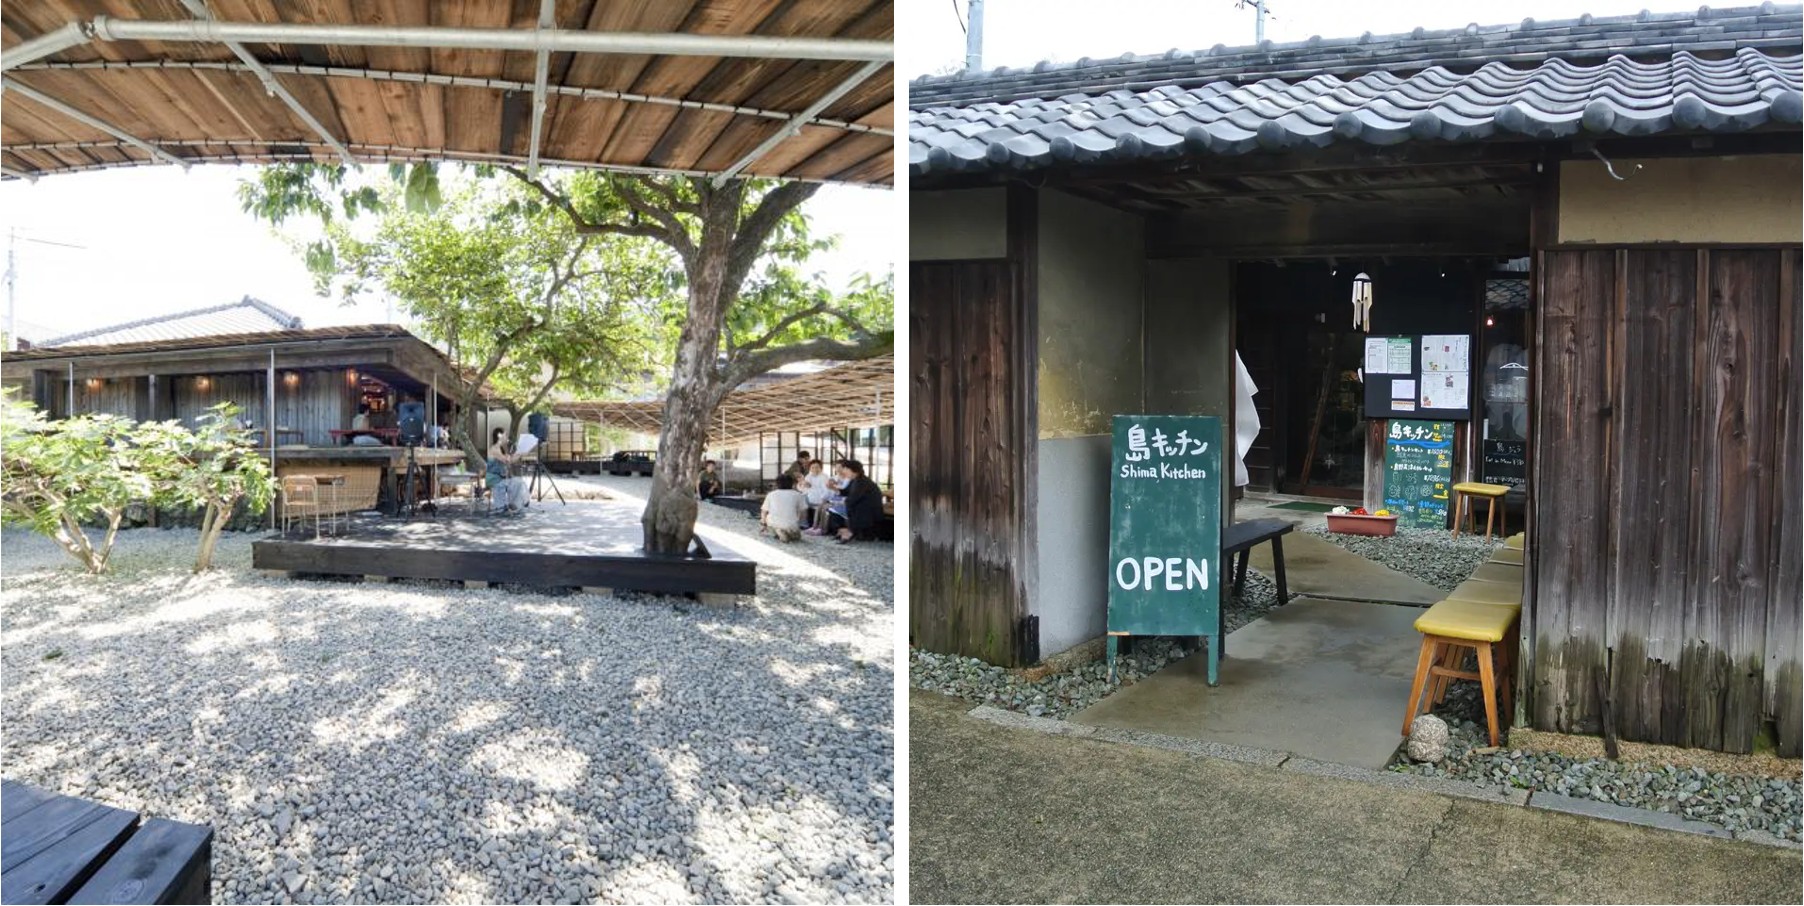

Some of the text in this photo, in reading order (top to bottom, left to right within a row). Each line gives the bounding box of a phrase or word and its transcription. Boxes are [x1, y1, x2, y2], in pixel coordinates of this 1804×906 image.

[1125, 423, 1208, 461] 島キッチン
[1389, 421, 1433, 440] 島キッチン
[1120, 461, 1207, 479] Shima Kitchen
[1116, 556, 1208, 591] OPEN
